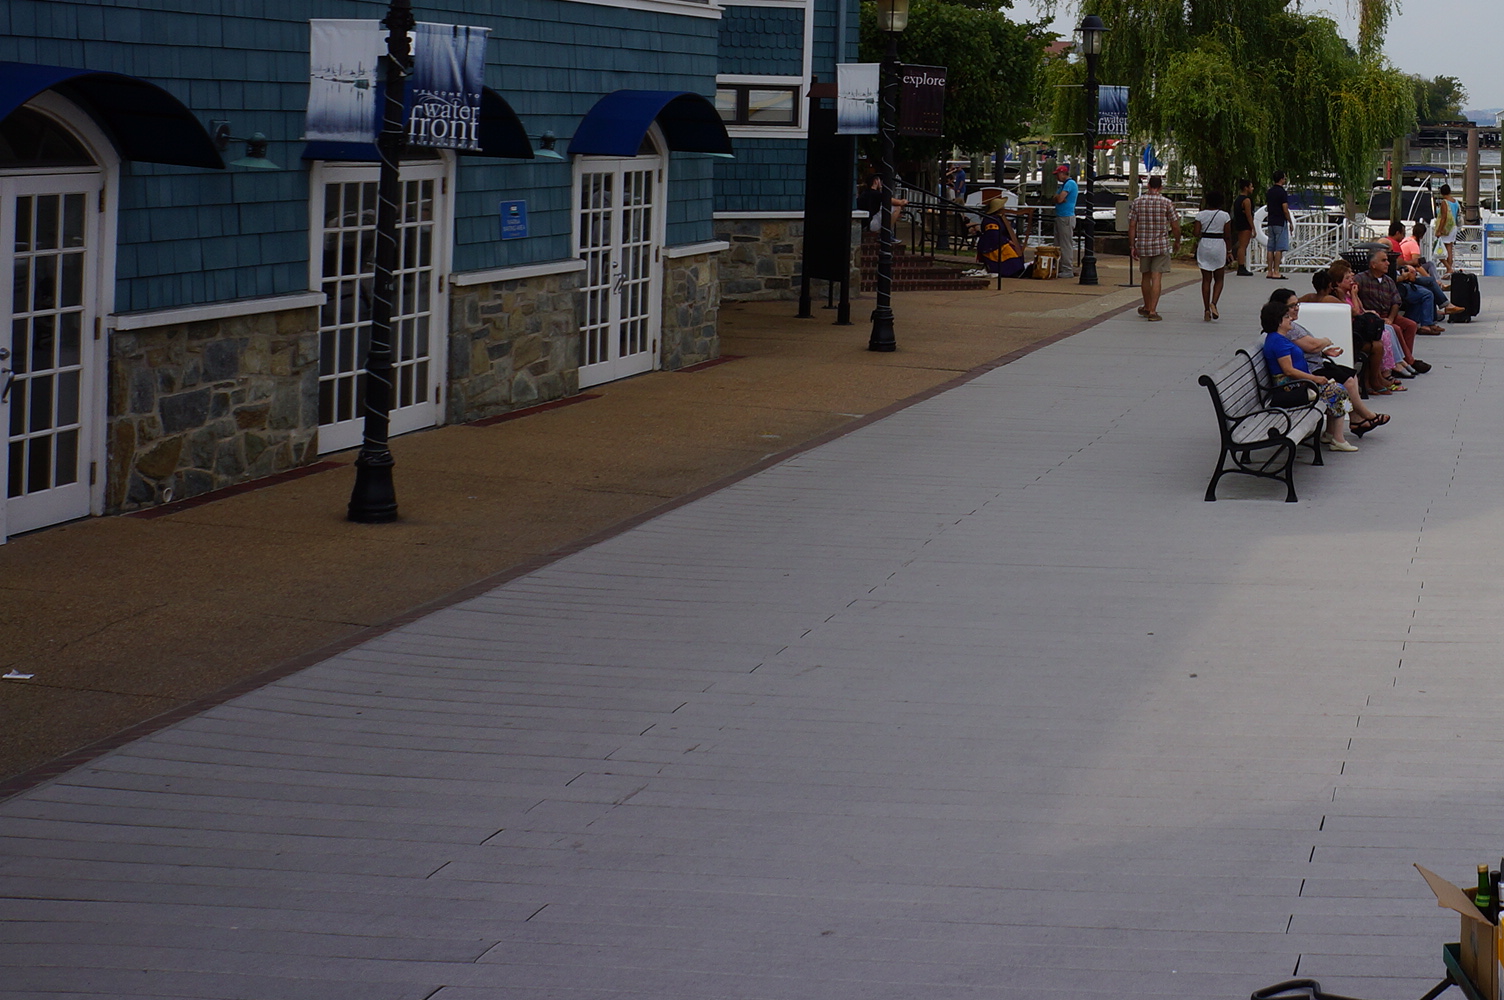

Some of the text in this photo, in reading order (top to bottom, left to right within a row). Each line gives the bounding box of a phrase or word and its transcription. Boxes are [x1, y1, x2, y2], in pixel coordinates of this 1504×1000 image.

[903, 72, 946, 88] explore
[413, 89, 461, 97] WELCOME
[424, 101, 480, 120] water
[408, 105, 479, 141] front
[1098, 117, 1128, 132] front
[409, 139, 476, 149] ALEXANDRIA
